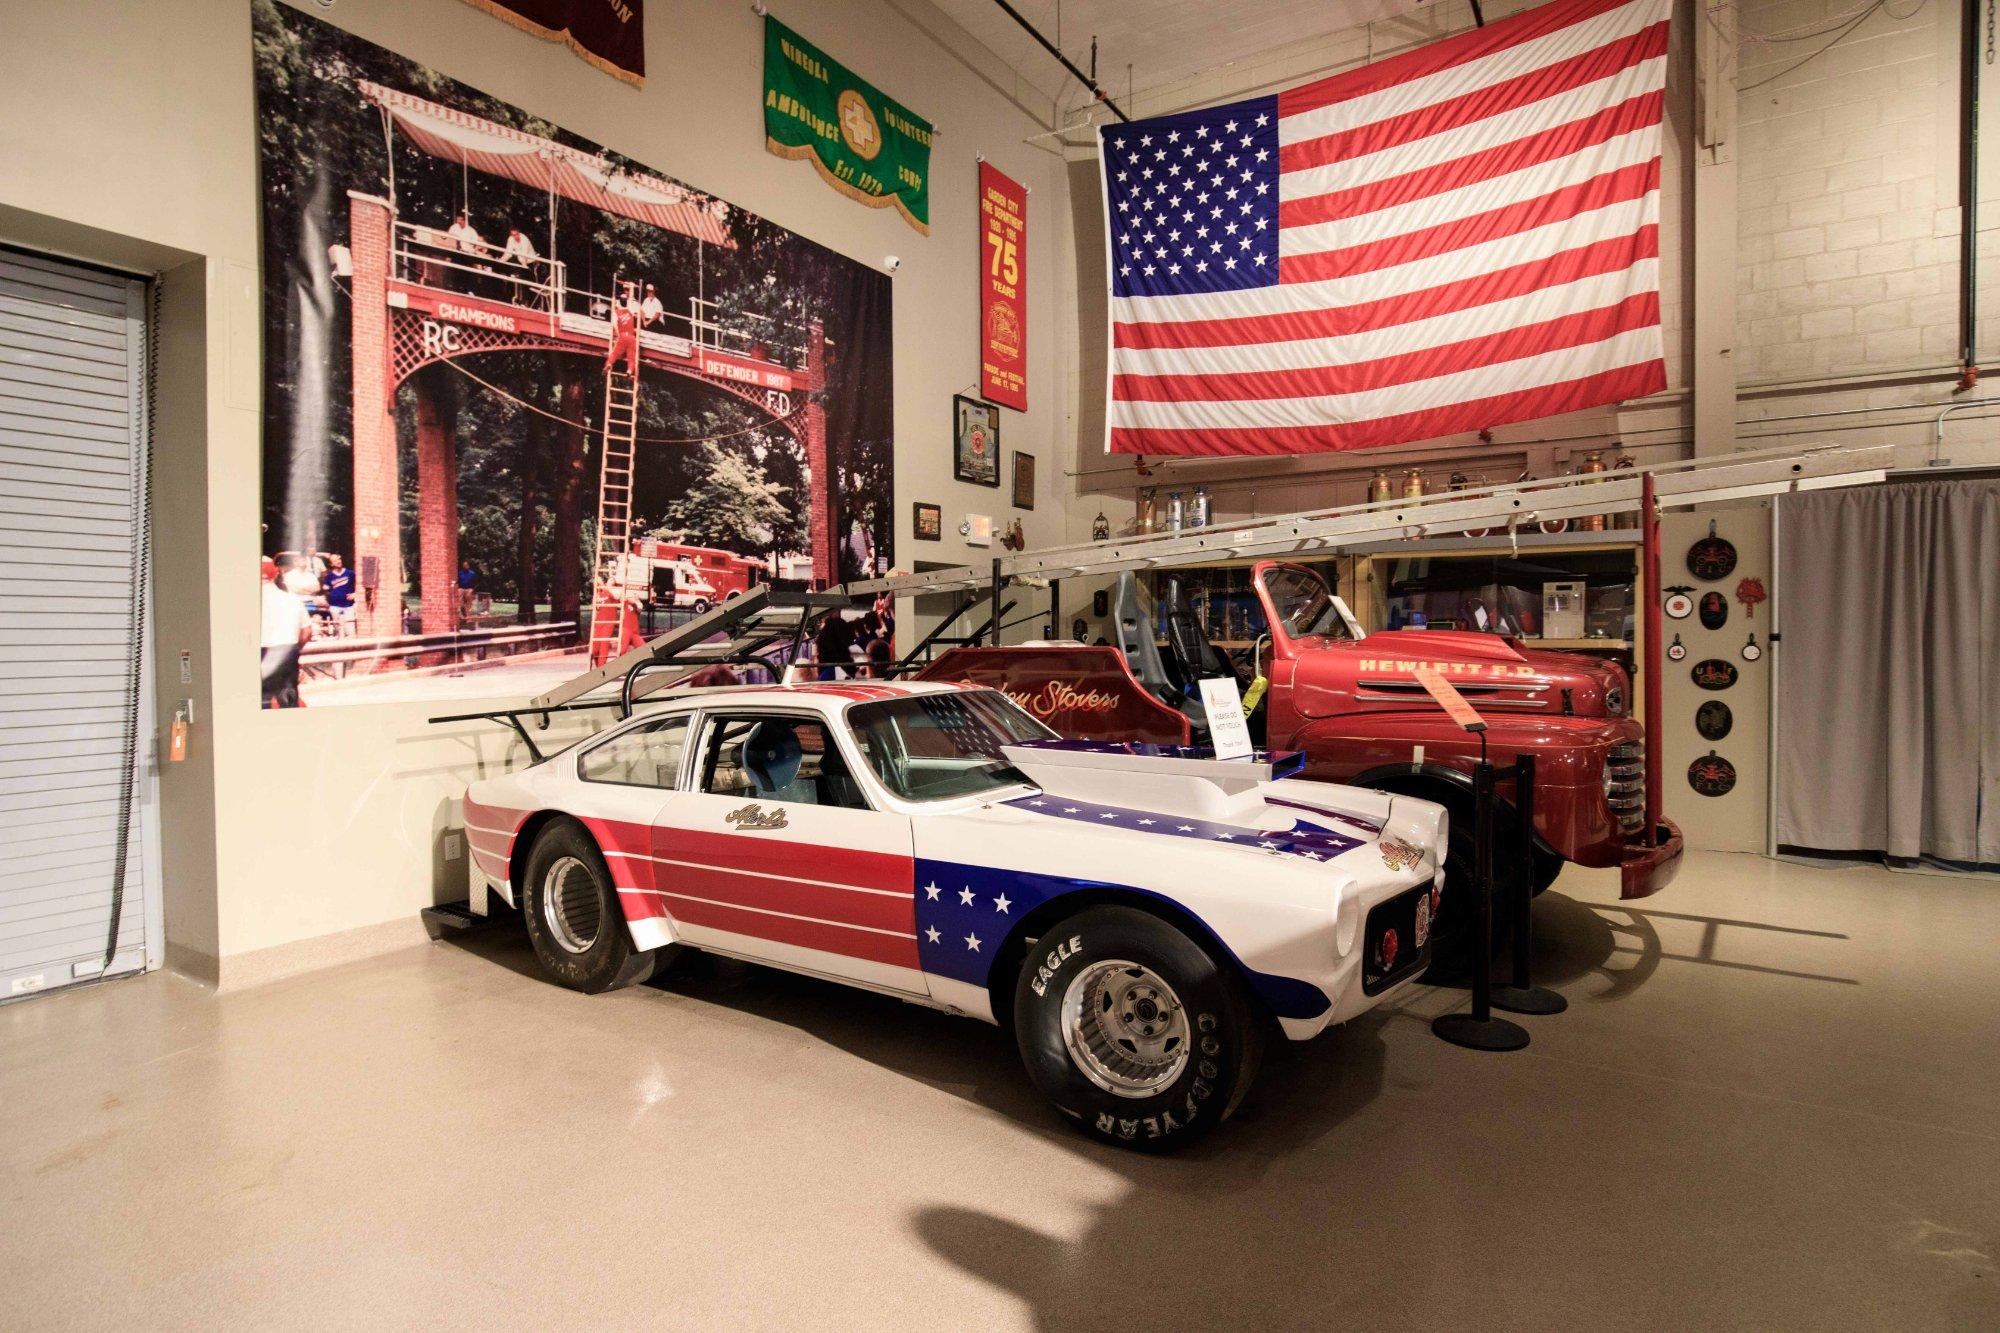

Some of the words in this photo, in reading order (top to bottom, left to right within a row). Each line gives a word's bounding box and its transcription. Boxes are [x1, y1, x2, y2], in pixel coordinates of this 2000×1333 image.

[780, 38, 829, 84] MINEOLA
[766, 89, 839, 143] AMBULANCE
[858, 172, 883, 196] 1979
[988, 231, 1018, 286] 75
[992, 279, 1016, 299] YEARS
[438, 303, 515, 331] CHAMPIONS
[423, 321, 460, 358] RC
[706, 360, 759, 384] DEFENDER
[1359, 659, 1483, 675] HEWLETT
[1033, 680, 1121, 715] Stovers
[1031, 934, 1083, 997] EAGLE
